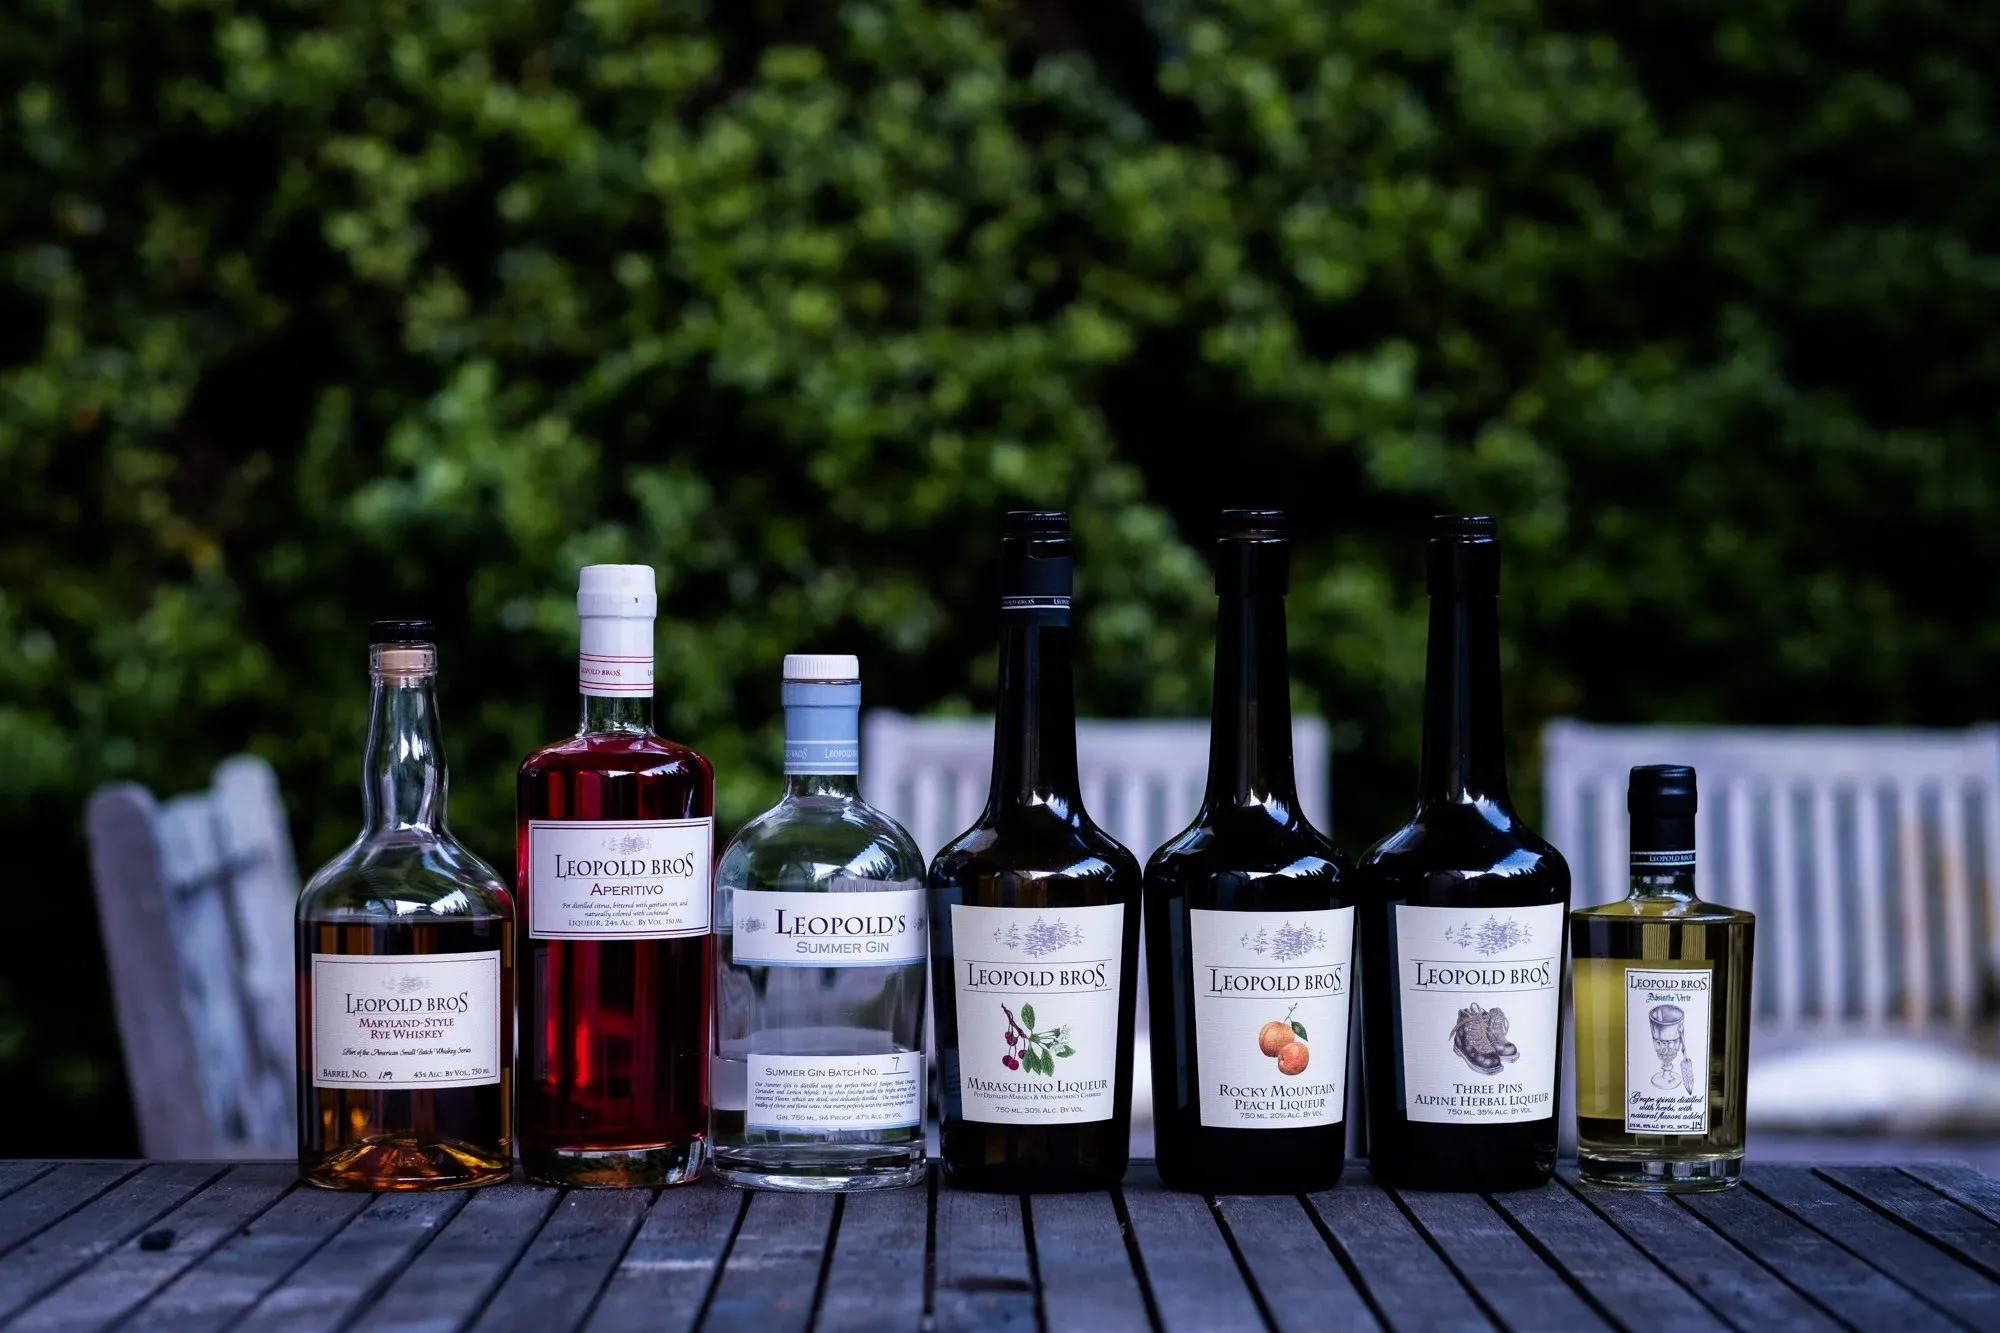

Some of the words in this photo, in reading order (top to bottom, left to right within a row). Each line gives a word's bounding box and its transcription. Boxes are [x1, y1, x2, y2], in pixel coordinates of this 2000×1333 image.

[554, 854, 646, 881] LEOPOLD
[651, 851, 694, 879] BROS
[590, 883, 664, 896] APERITIVO
[613, 900, 634, 908] bittered
[585, 910, 611, 919] naturally
[774, 909, 906, 938] LEOPOLD'S
[796, 941, 862, 954] SUMMER
[866, 941, 889, 953] GIN
[968, 963, 1054, 991] LEOPOLD
[1060, 963, 1108, 988] BROS.
[1416, 962, 1505, 989] LEOPOLD
[1210, 969, 1300, 996] LEOPOLD
[1630, 976, 1678, 990] LEOPOLD
[345, 993, 422, 1016] LEOPOLD
[428, 991, 468, 1014] BROS
[1646, 992, 1674, 1003] Absinthe
[359, 1018, 454, 1028] MARYLAND-STYLE
[370, 1030, 390, 1040] RYE
[393, 1029, 444, 1039] WHISKEY
[892, 1056, 900, 1071] 7
[323, 1068, 350, 1078] BARREL
[352, 1070, 369, 1078] NO.
[766, 1068, 804, 1076] SUMMER
[808, 1068, 826, 1076] GIN
[828, 1068, 860, 1076] BATCH
[862, 1068, 878, 1076] NO.
[968, 1077, 1053, 1092] MARASCHINO
[1057, 1080, 1108, 1093] LIQUEUR
[1220, 1084, 1267, 1098] ROCKY
[1271, 1083, 1336, 1097] MOUNTAIN
[1453, 1084, 1494, 1094] THREE
[1498, 1083, 1522, 1092] PINS
[1234, 1100, 1274, 1110] PEACH
[1280, 1098, 1326, 1112] LIQUEUR
[1415, 1094, 1456, 1106] ALPINE
[1460, 1095, 1506, 1106] HERBAL
[1510, 1092, 1550, 1106] LIQUEUR
[1630, 1092, 1654, 1105] Grape
[1656, 1096, 1676, 1105] spirits
[1677, 1095, 1704, 1103] distilled
[1682, 1112, 1705, 1120] added
